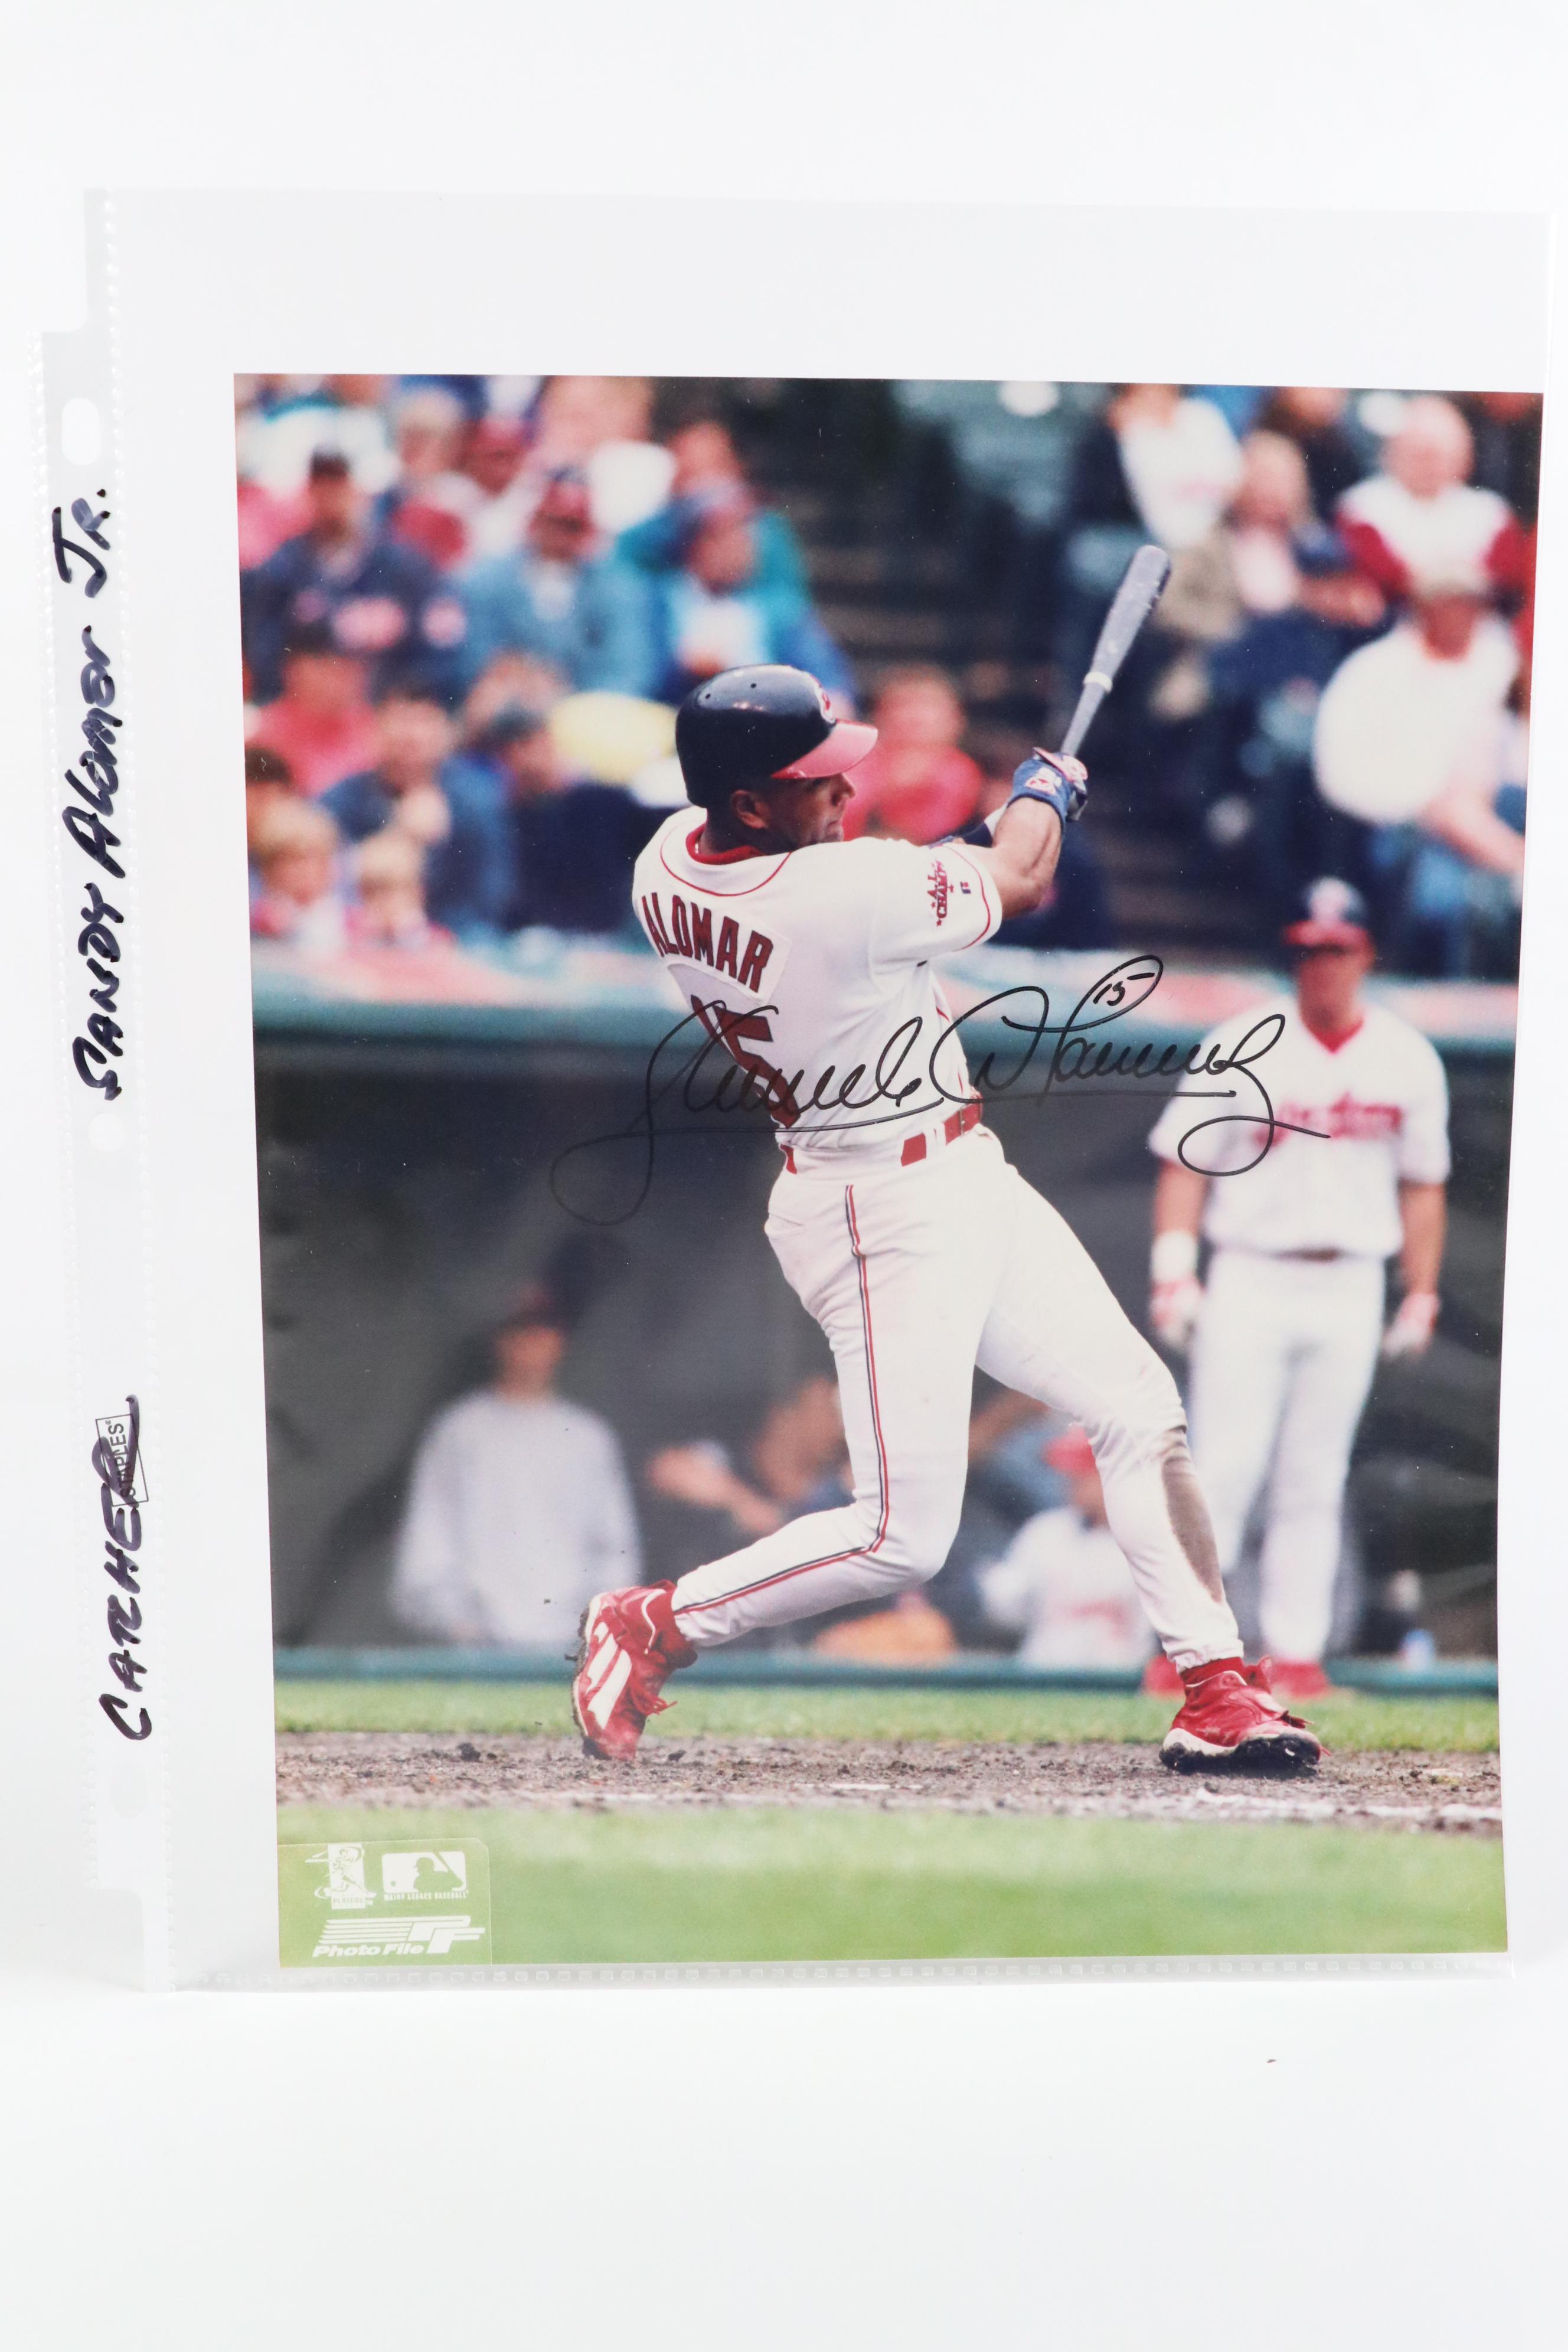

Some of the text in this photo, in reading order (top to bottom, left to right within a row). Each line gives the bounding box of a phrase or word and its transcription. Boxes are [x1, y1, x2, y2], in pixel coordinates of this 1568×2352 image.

[73, 882, 125, 1102] SANDY
[641, 892, 773, 993] ALOMAR
[92, 1394, 152, 1741] CATCHER
[312, 1942, 424, 1958] Photo File
